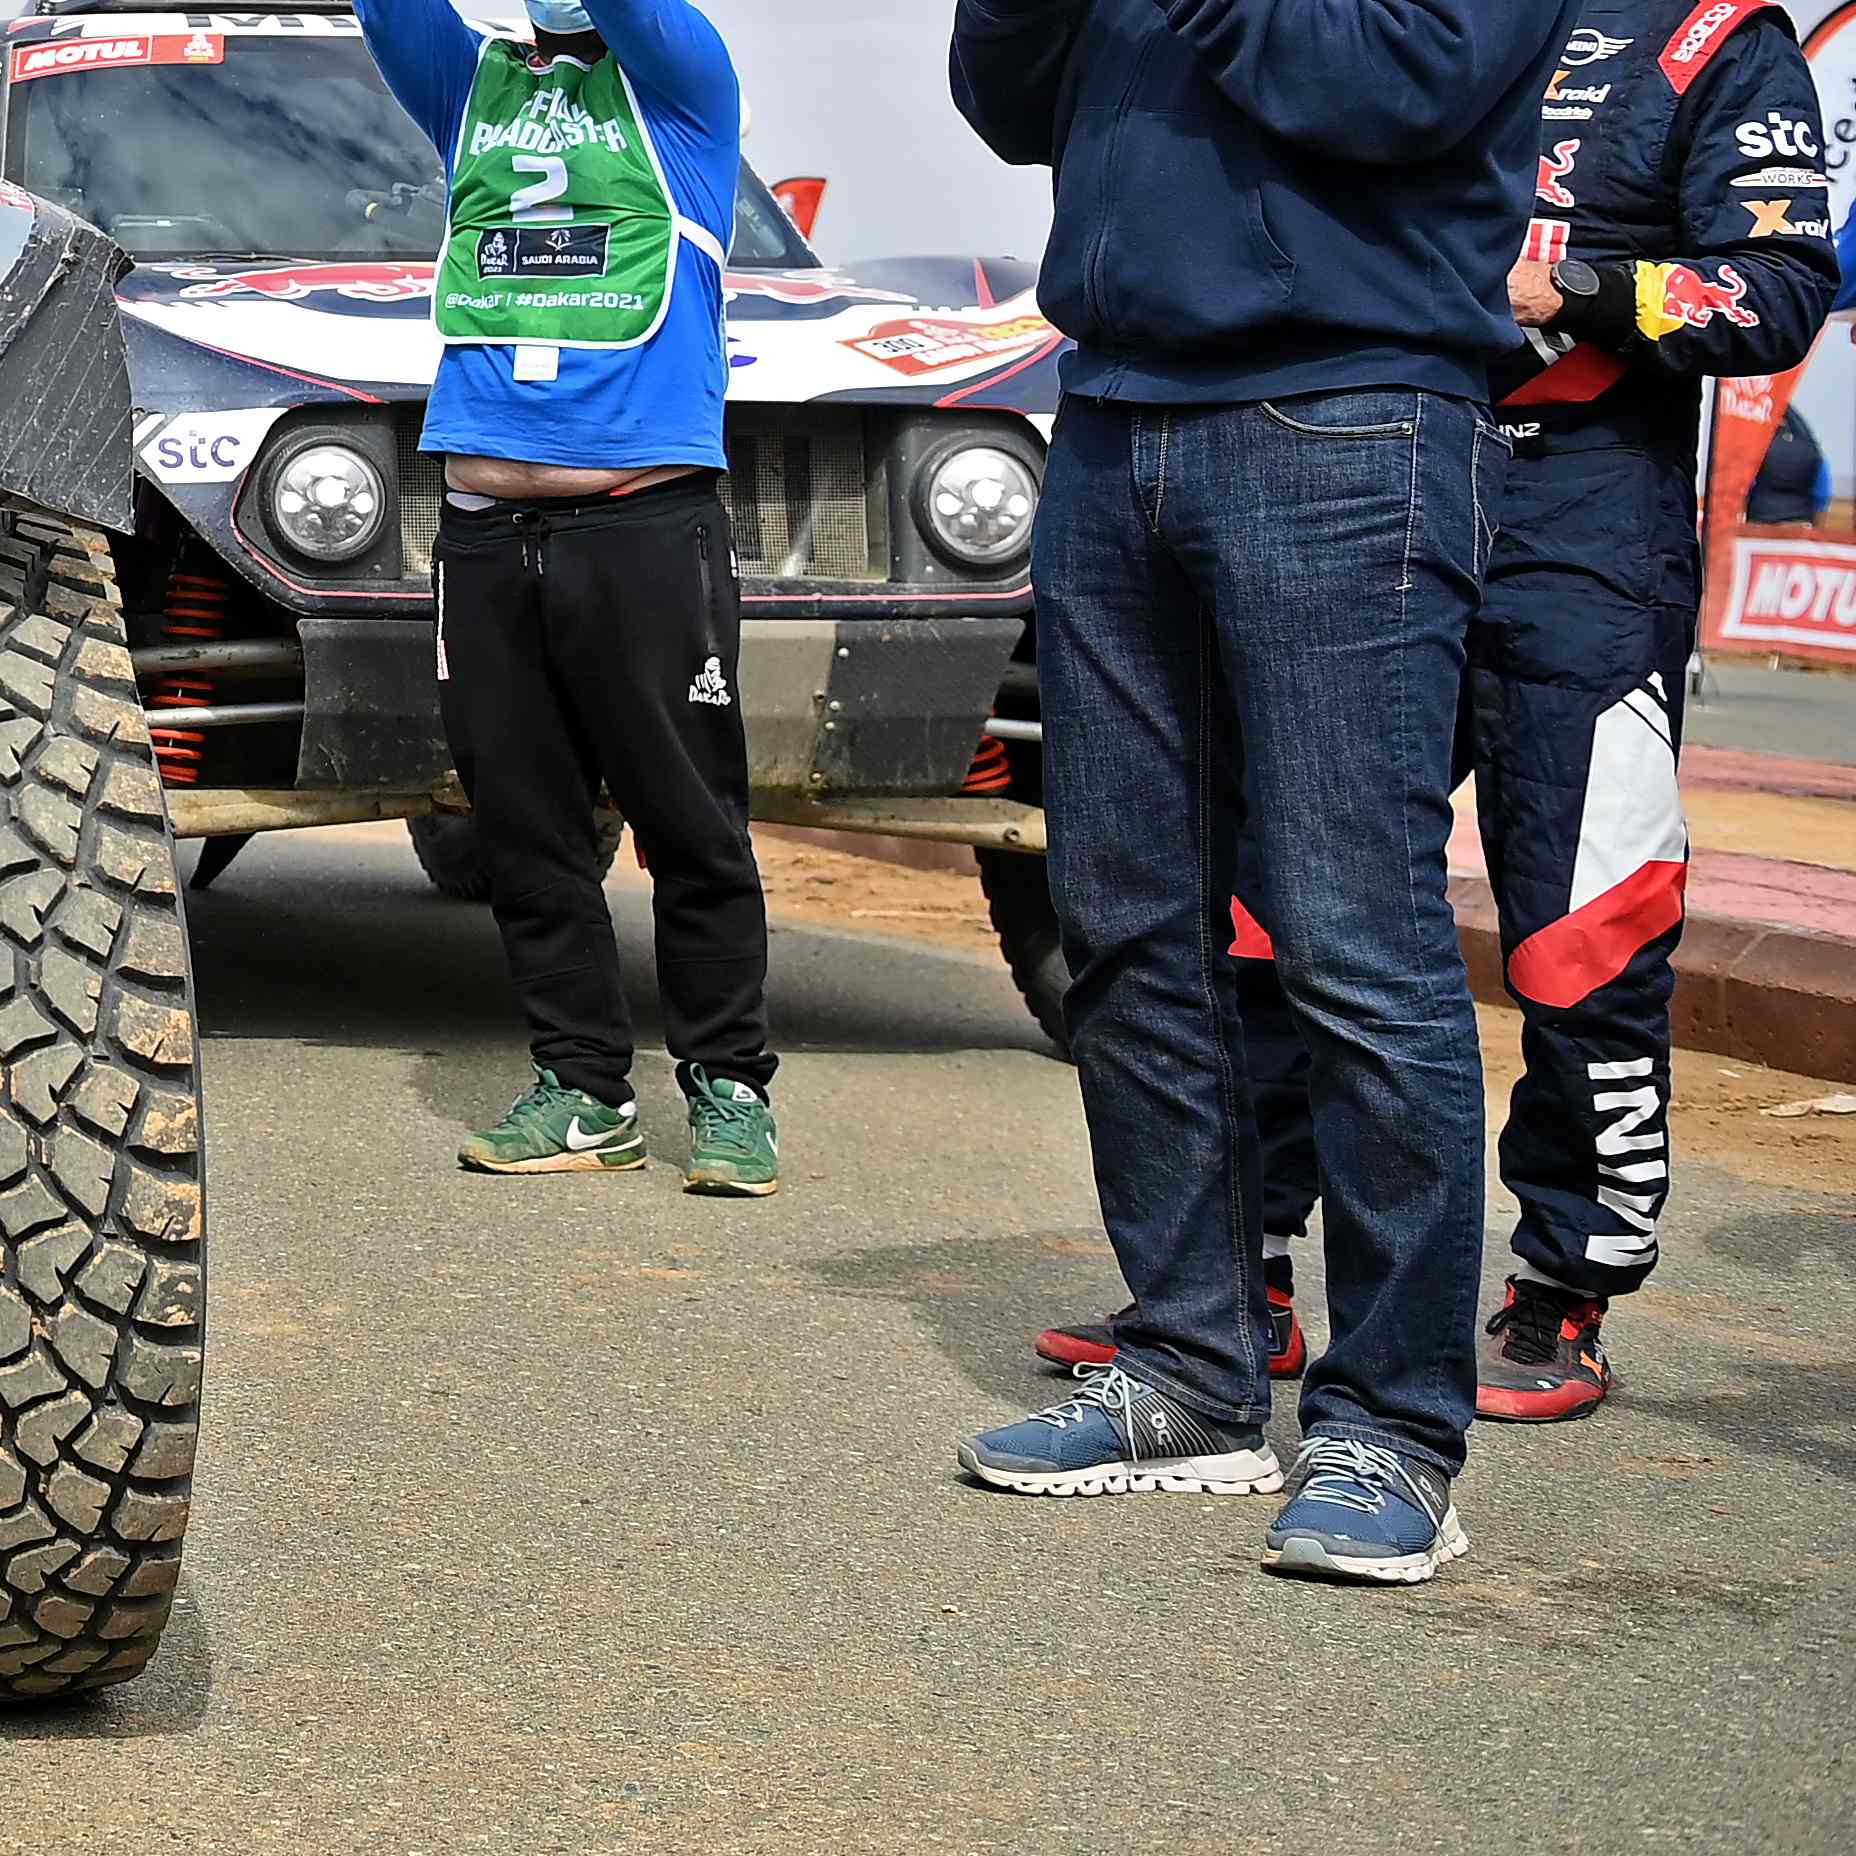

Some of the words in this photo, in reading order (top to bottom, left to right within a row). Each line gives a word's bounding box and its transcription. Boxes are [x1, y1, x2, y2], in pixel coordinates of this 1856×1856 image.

[24, 40, 143, 72] MOTUL
[1735, 112, 1819, 158] stc
[509, 154, 575, 223] 2
[521, 254, 553, 265] SAUDI
[555, 254, 599, 265] ARABIA
[158, 432, 241, 469] stc
